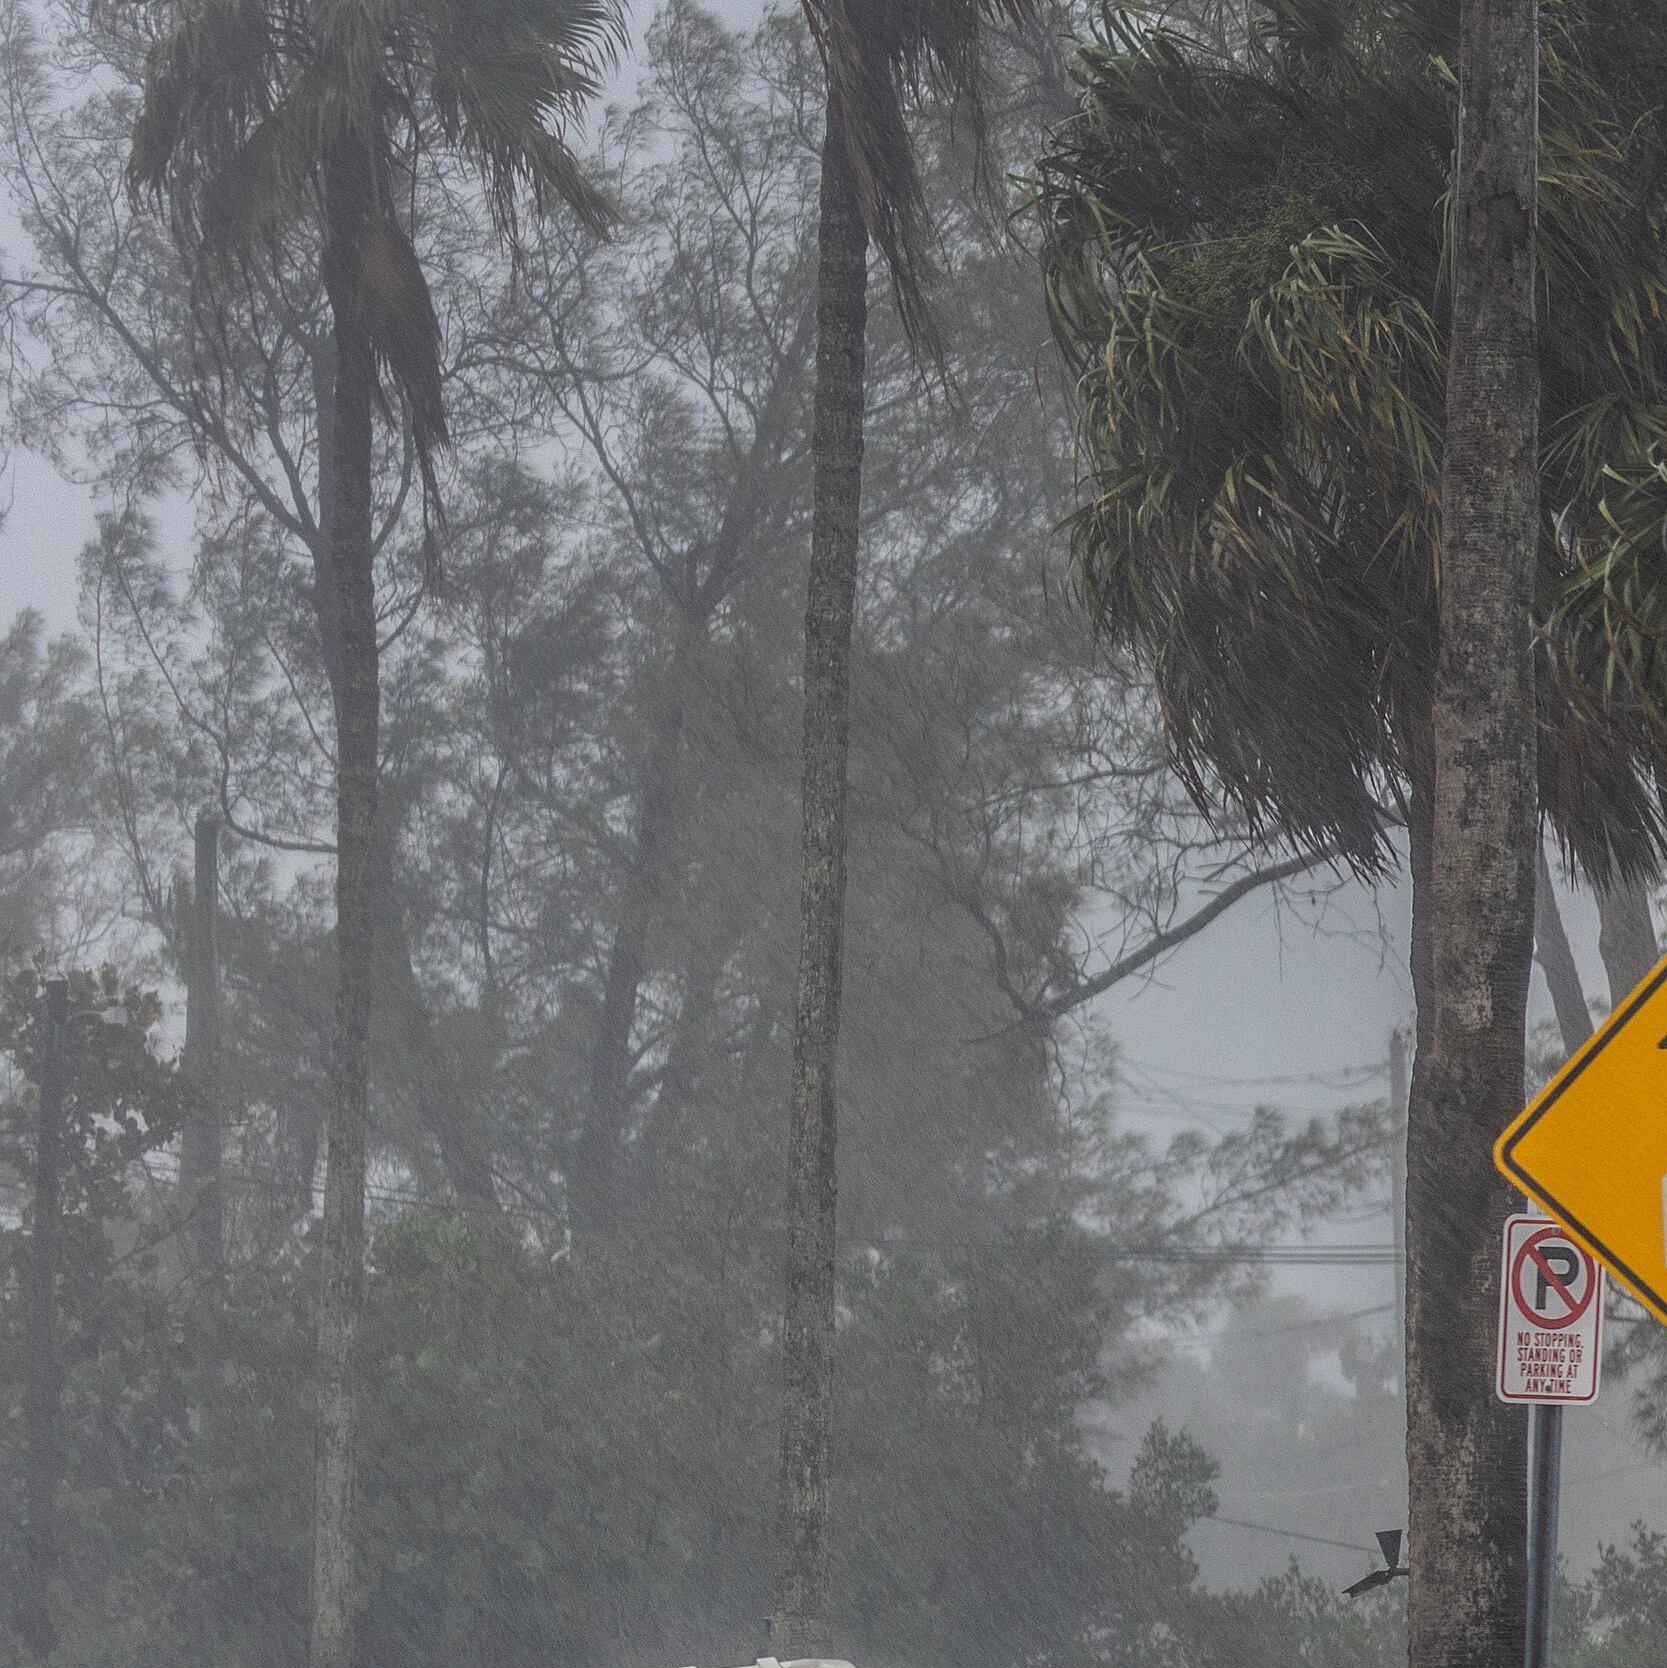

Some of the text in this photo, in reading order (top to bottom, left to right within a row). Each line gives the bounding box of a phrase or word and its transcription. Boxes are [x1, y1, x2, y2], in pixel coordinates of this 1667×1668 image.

[1516, 1332, 1584, 1349] NO STOPPING,
[1516, 1349, 1583, 1363] STANDING OR
[1520, 1364, 1579, 1379] PARKING AT
[1524, 1379, 1572, 1394] ANY TIME
